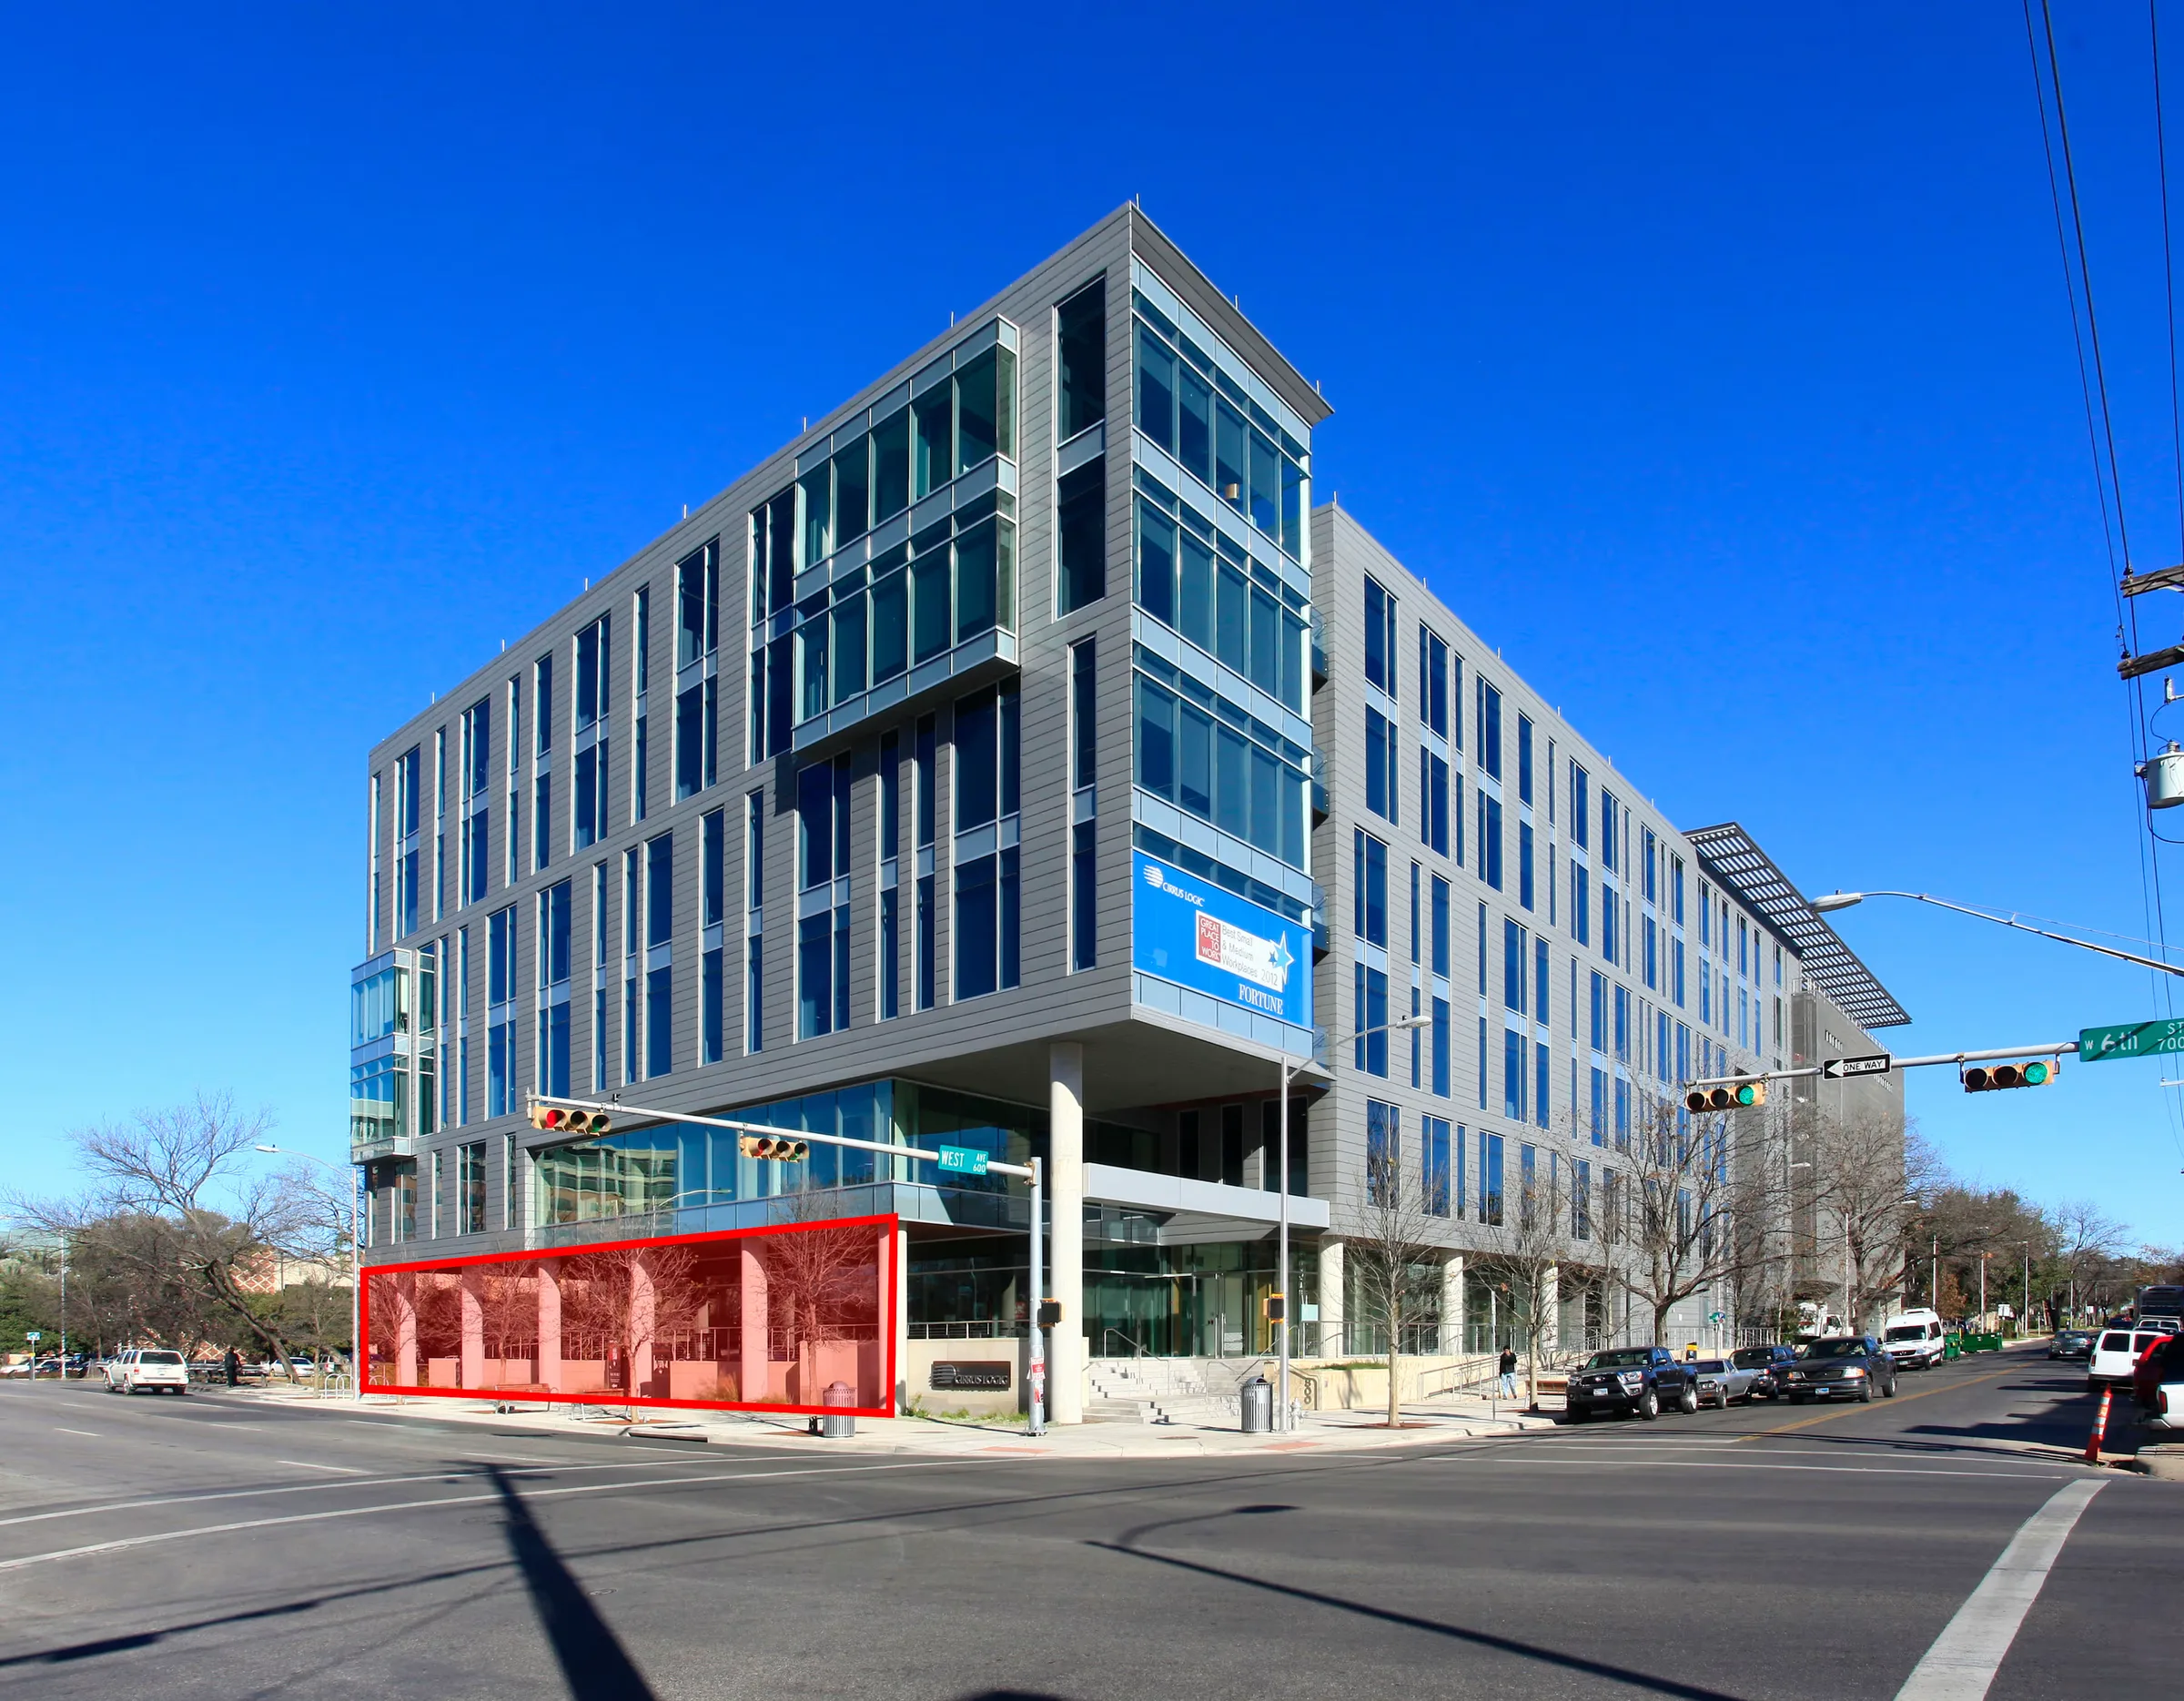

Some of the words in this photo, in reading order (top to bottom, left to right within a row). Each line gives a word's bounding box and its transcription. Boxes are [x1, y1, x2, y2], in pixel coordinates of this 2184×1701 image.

[1163, 881, 1184, 898] CIRRUS
[1184, 890, 1205, 907] LOGIC
[1200, 917, 1219, 933] GREAT
[1200, 926, 1219, 943] PLACE
[1222, 924, 1236, 940] Best
[1237, 931, 1253, 947] Small
[1201, 946, 1220, 961] WORK
[1210, 940, 1219, 951] TO
[1221, 939, 1227, 950] &
[1228, 942, 1254, 961] Medium
[1222, 953, 1258, 977] Workplaces
[1261, 968, 1279, 987] 2012
[1239, 983, 1284, 1016] FORTUNE
[2167, 1021, 2184, 1035] ST
[2084, 1039, 2094, 1050] W
[2100, 1031, 2138, 1053] 6th
[2158, 1036, 2184, 1051] 700
[1843, 1062, 1861, 1072] ONE
[1864, 1059, 1883, 1069] WAY
[941, 1149, 965, 1168] WEST
[976, 1153, 986, 1163] AVE
[973, 1163, 986, 1173] 600
[955, 1374, 982, 1384] CIRRUS
[983, 1374, 1008, 1384] LOGIC
